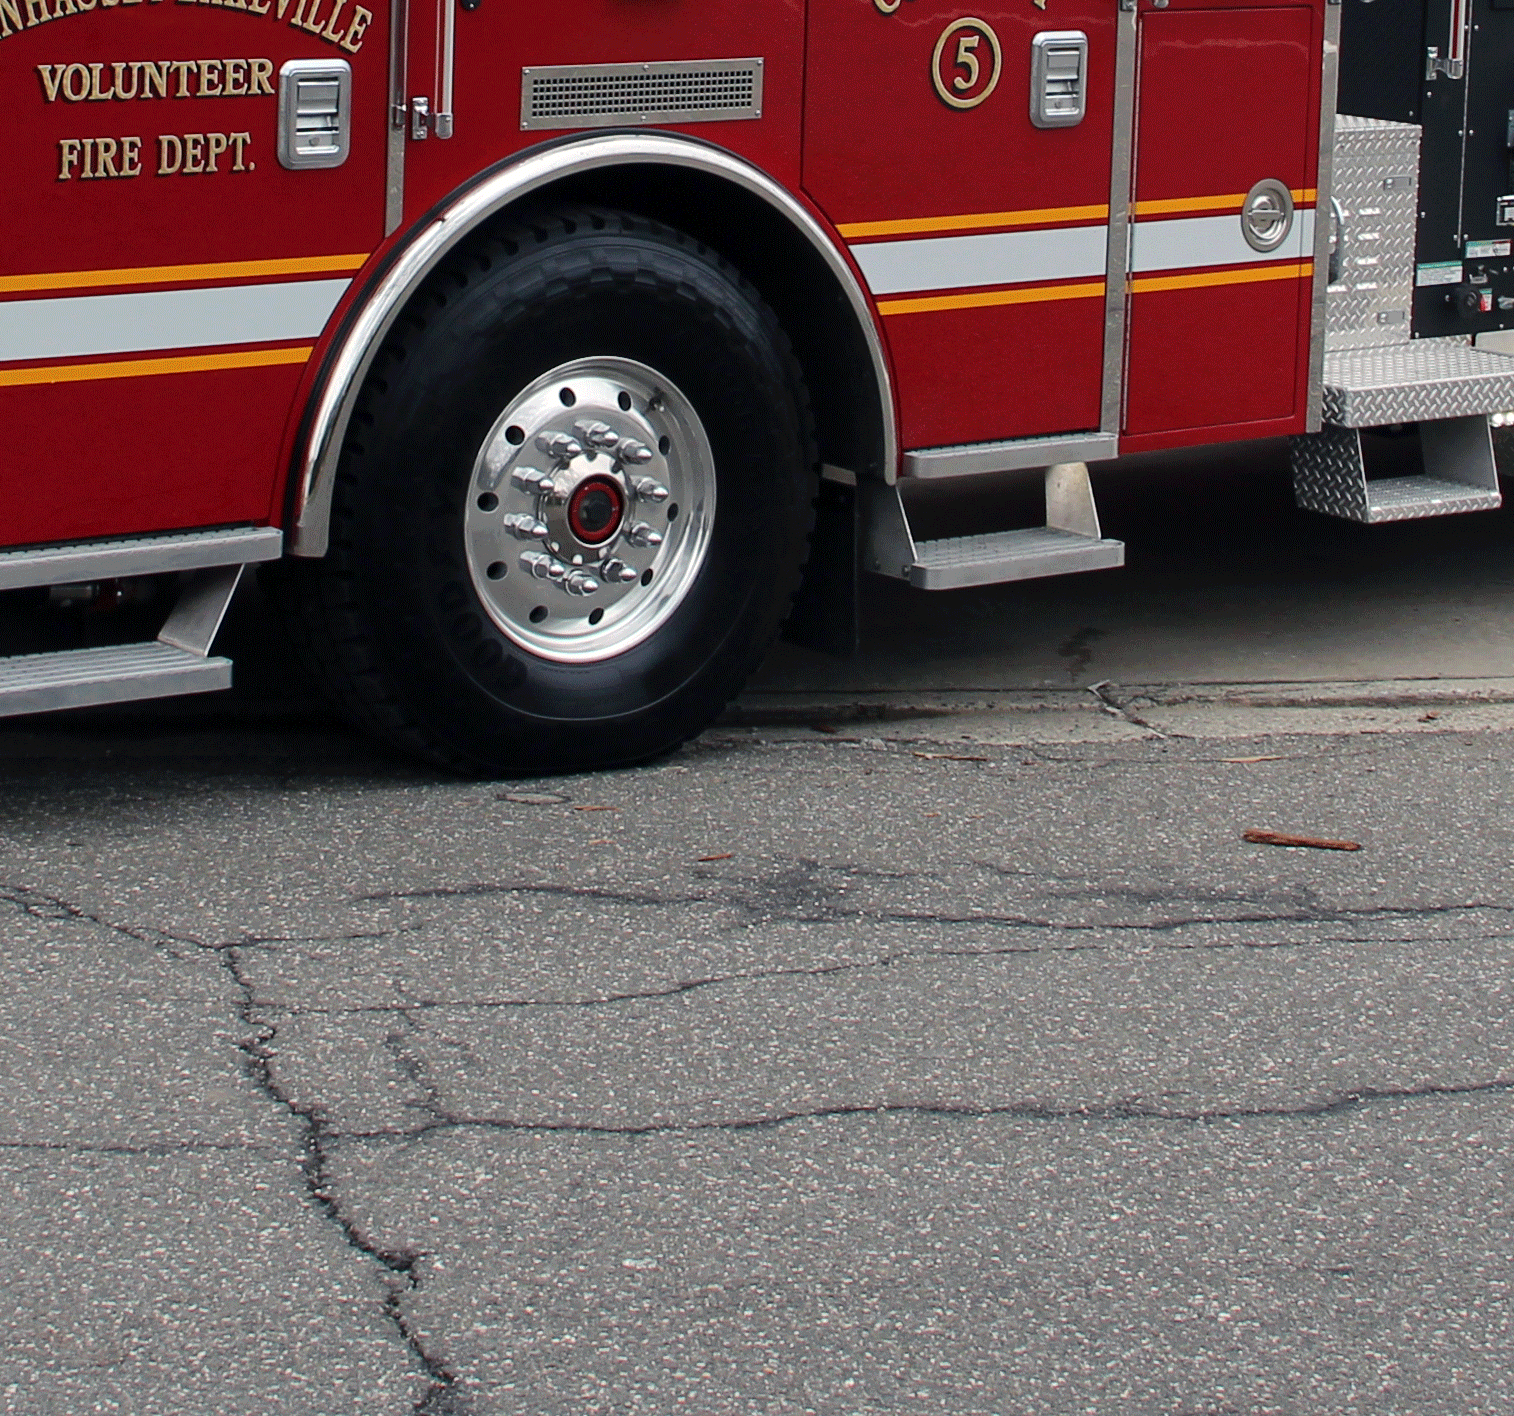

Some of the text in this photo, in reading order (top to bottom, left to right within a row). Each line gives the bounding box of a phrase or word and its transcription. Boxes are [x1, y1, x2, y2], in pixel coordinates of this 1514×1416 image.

[37, 58, 275, 102] VOLUNTEER
[953, 35, 980, 90] 5
[58, 131, 256, 181] FIRE DEPT.
